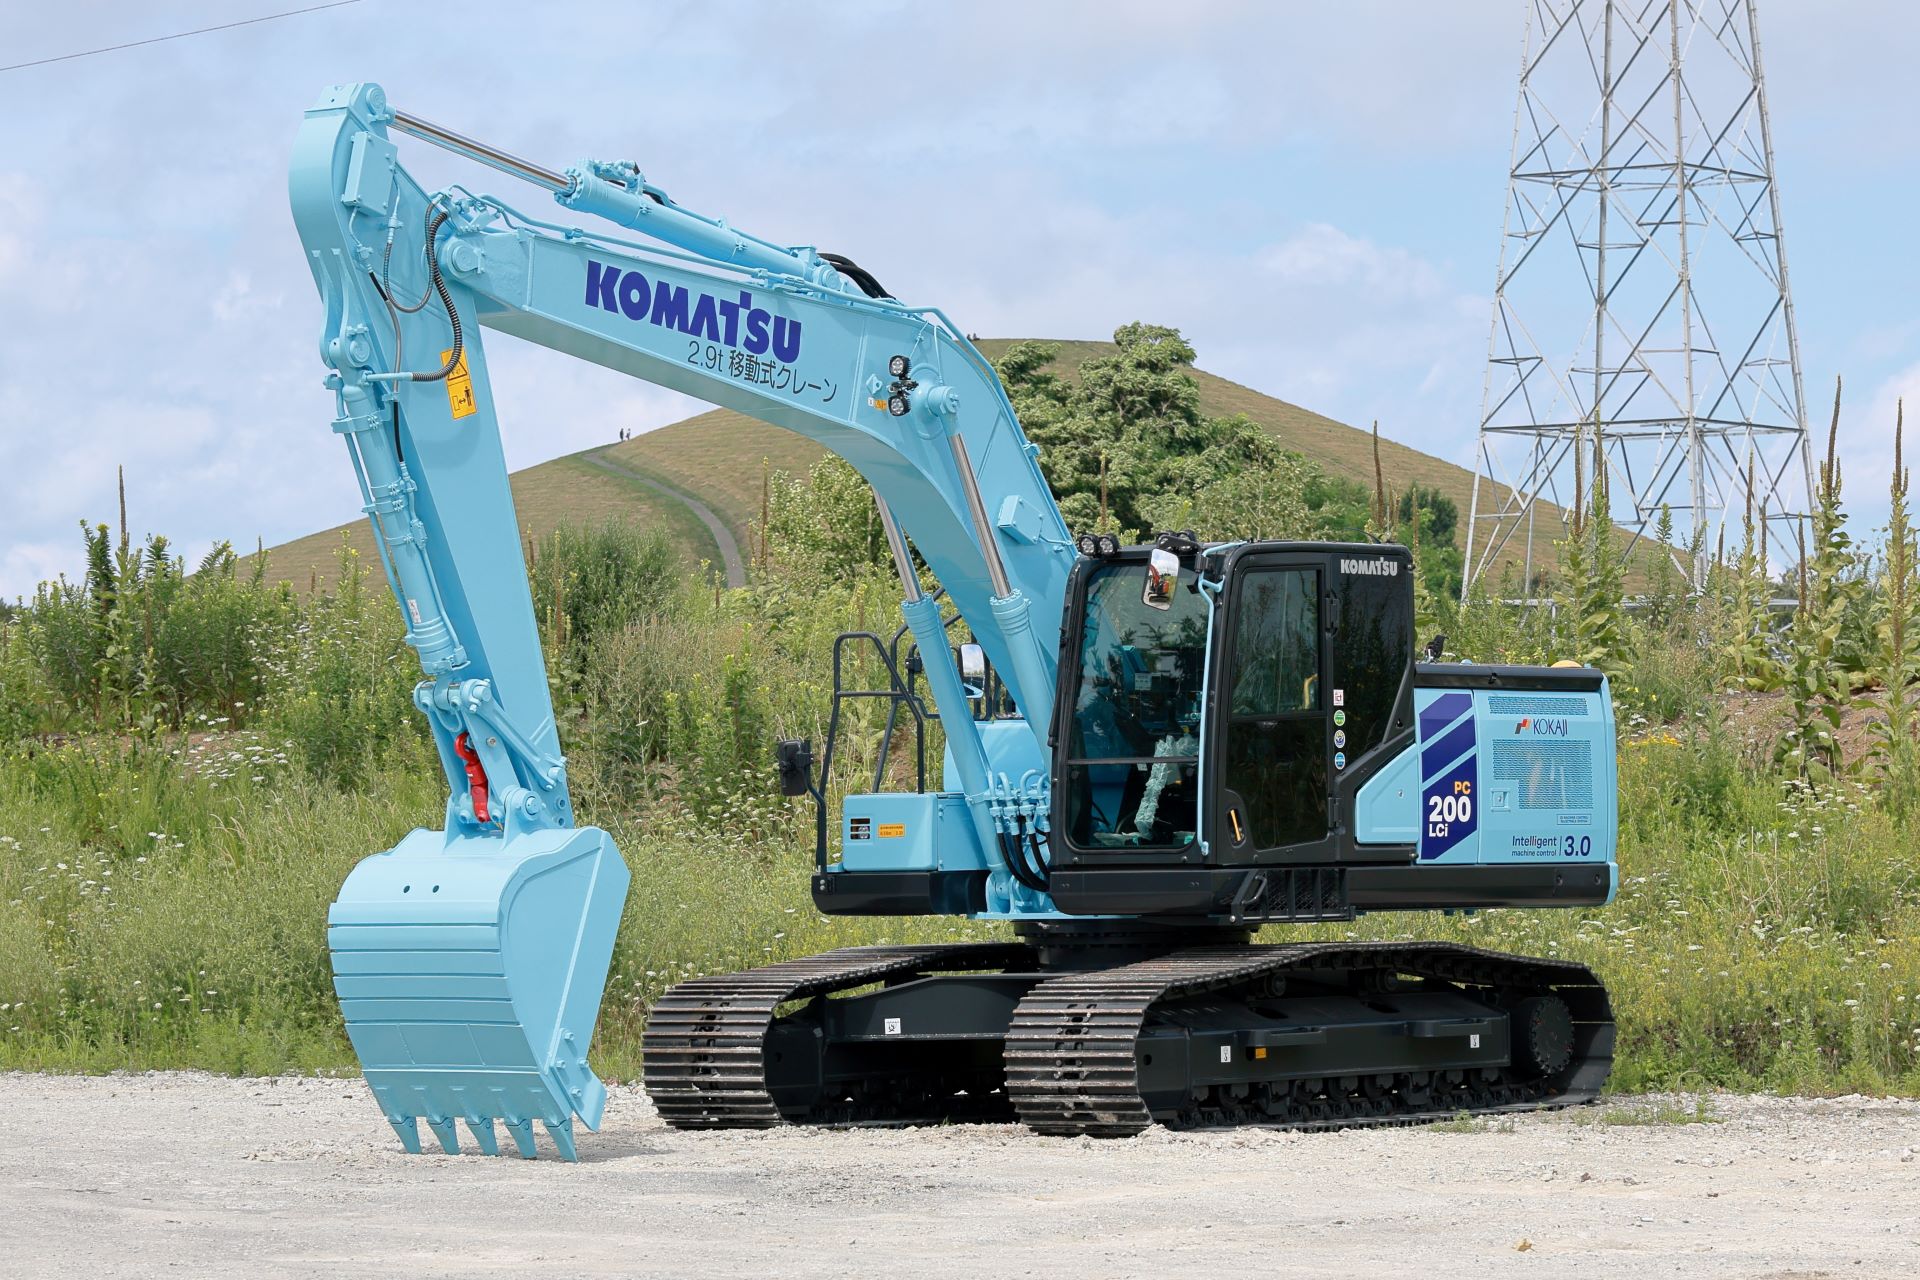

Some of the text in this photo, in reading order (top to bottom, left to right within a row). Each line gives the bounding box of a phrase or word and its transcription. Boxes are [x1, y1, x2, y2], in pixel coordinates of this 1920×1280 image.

[585, 260, 802, 364] KOMATSU
[687, 340, 838, 403] 2.9t 移動式クレーン
[1340, 557, 1398, 577] KOMATSU
[1533, 718, 1568, 737] KOKAJI
[1454, 781, 1471, 795] PC
[1428, 795, 1471, 823] 200
[1428, 823, 1449, 838] LCi
[1512, 835, 1557, 849] Intelligent
[1564, 835, 1591, 857] 3.0
[1511, 849, 1557, 857] machine control
